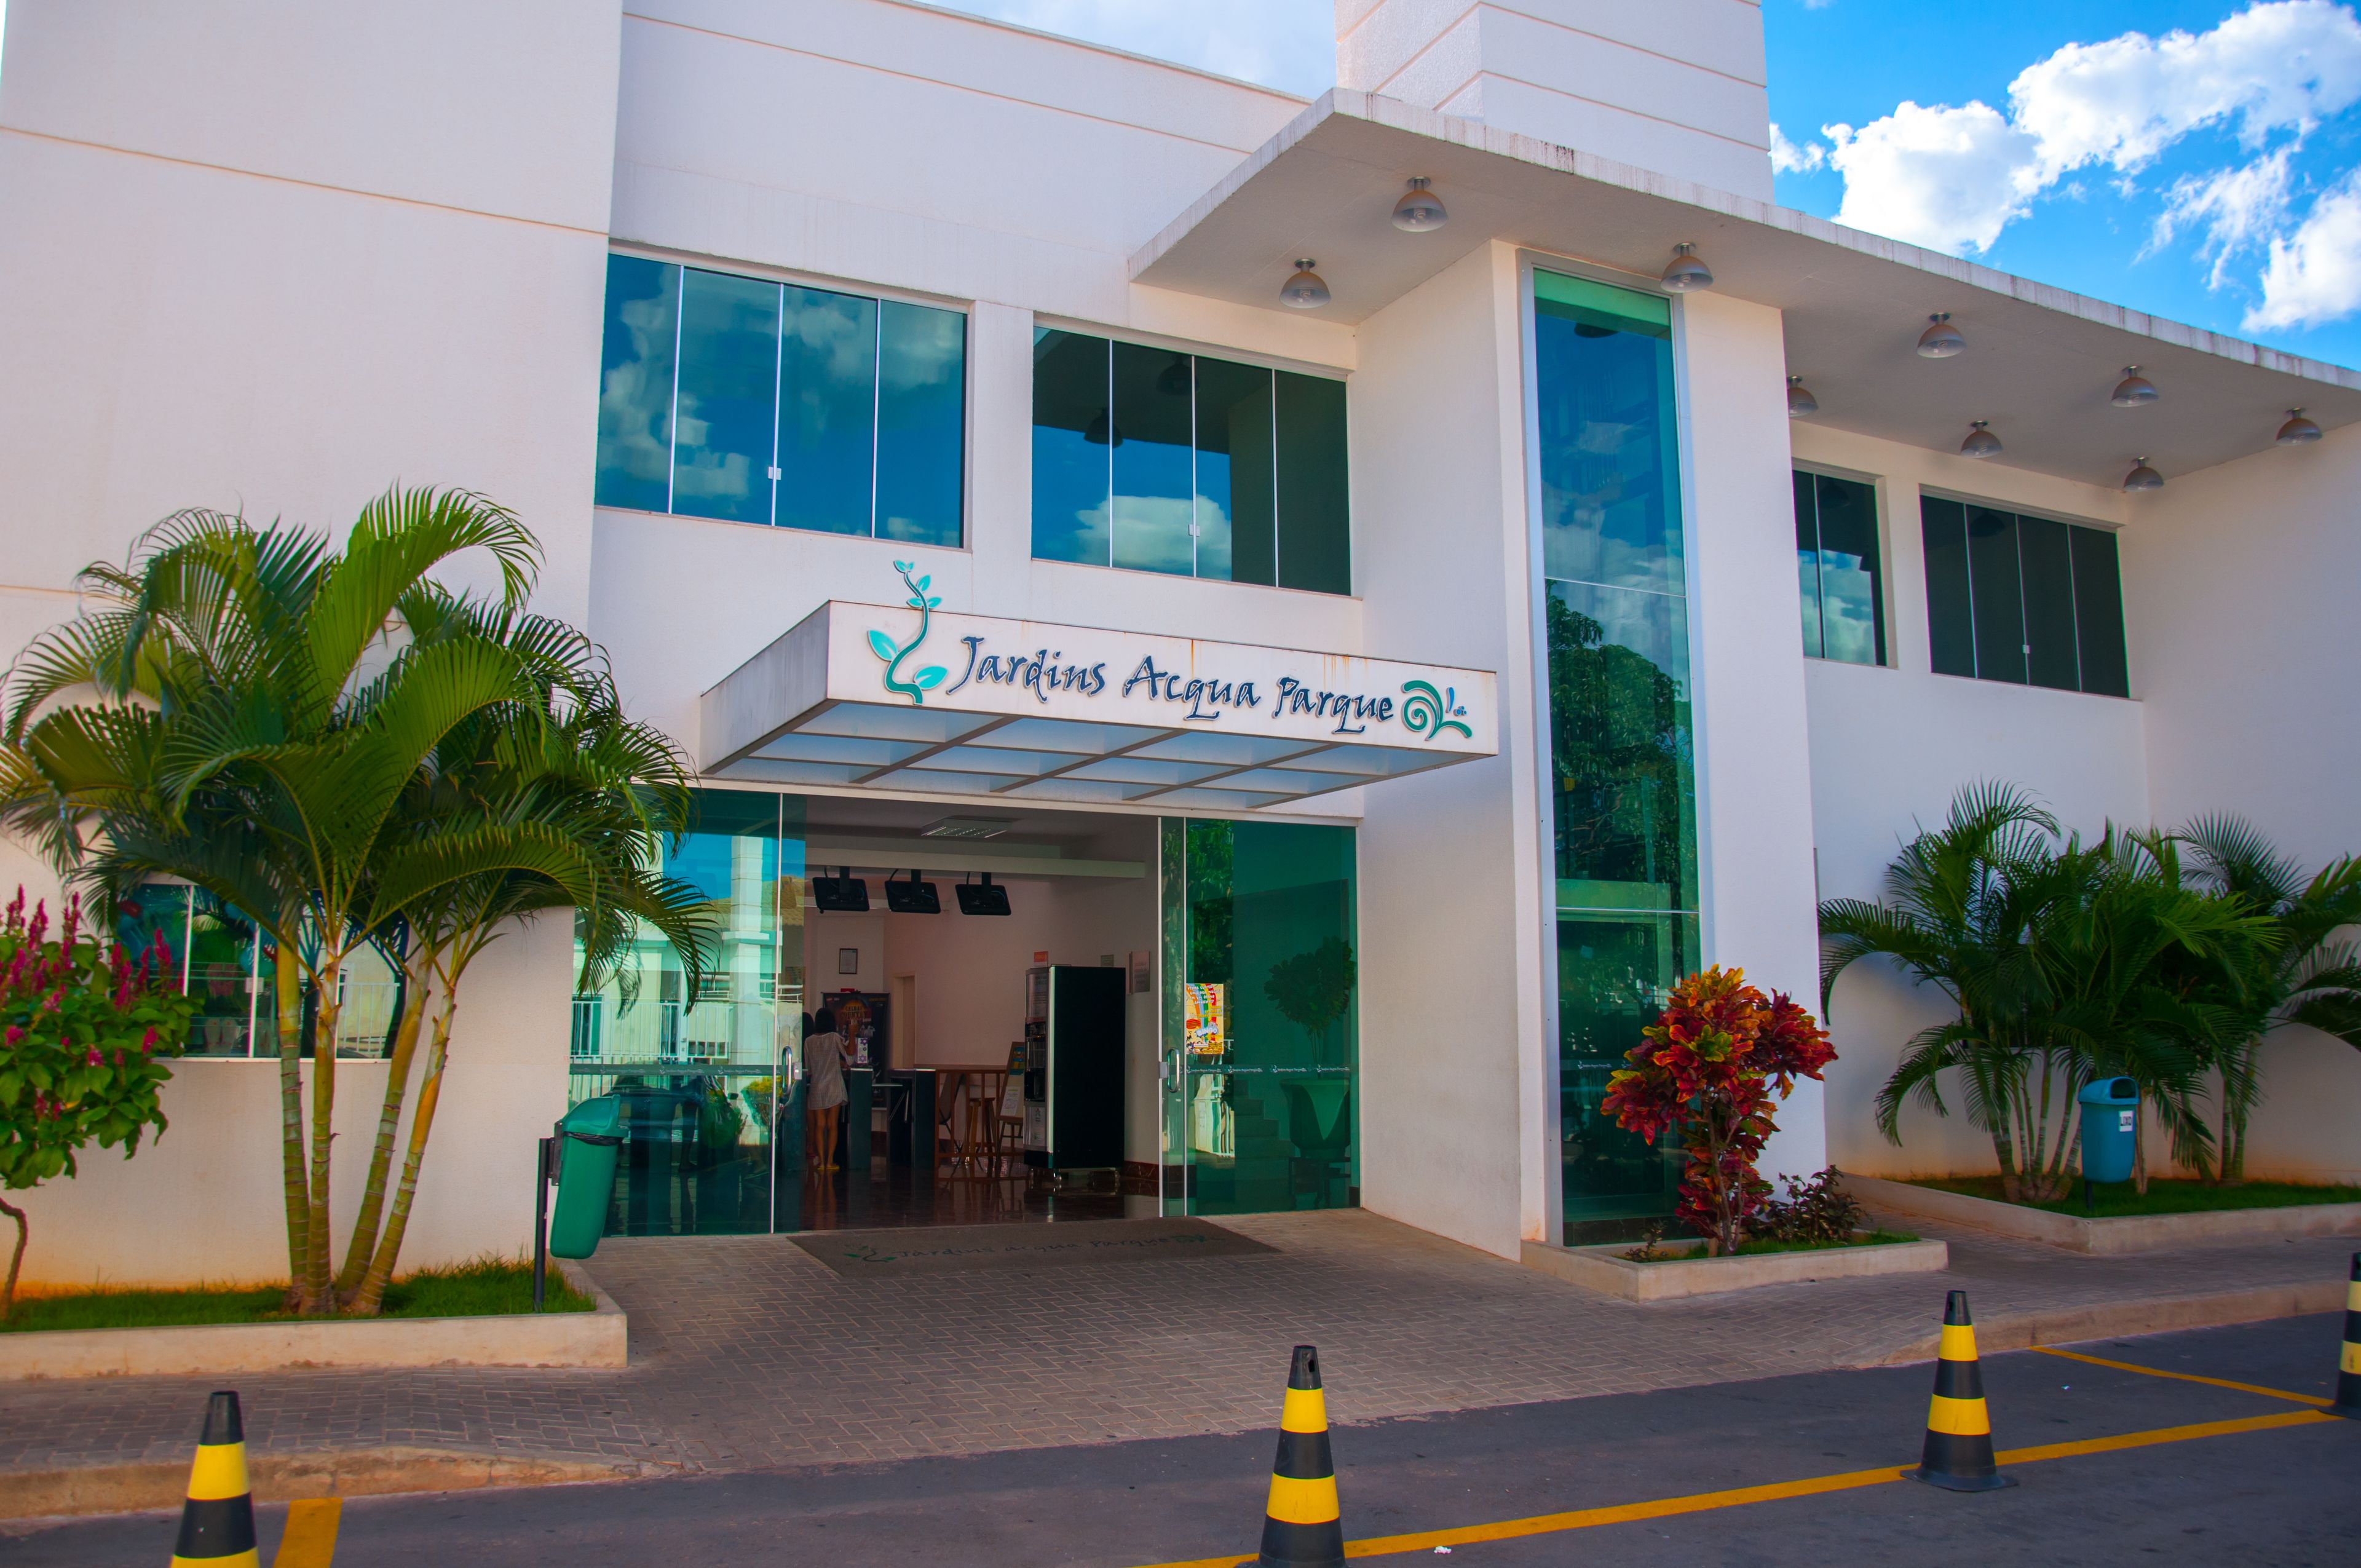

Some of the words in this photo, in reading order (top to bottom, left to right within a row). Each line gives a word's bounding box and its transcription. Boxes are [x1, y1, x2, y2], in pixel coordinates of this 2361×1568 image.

[947, 636, 1106, 703] Jardins
[1122, 654, 1261, 721] Acqua
[1271, 676, 1394, 735] Parque
